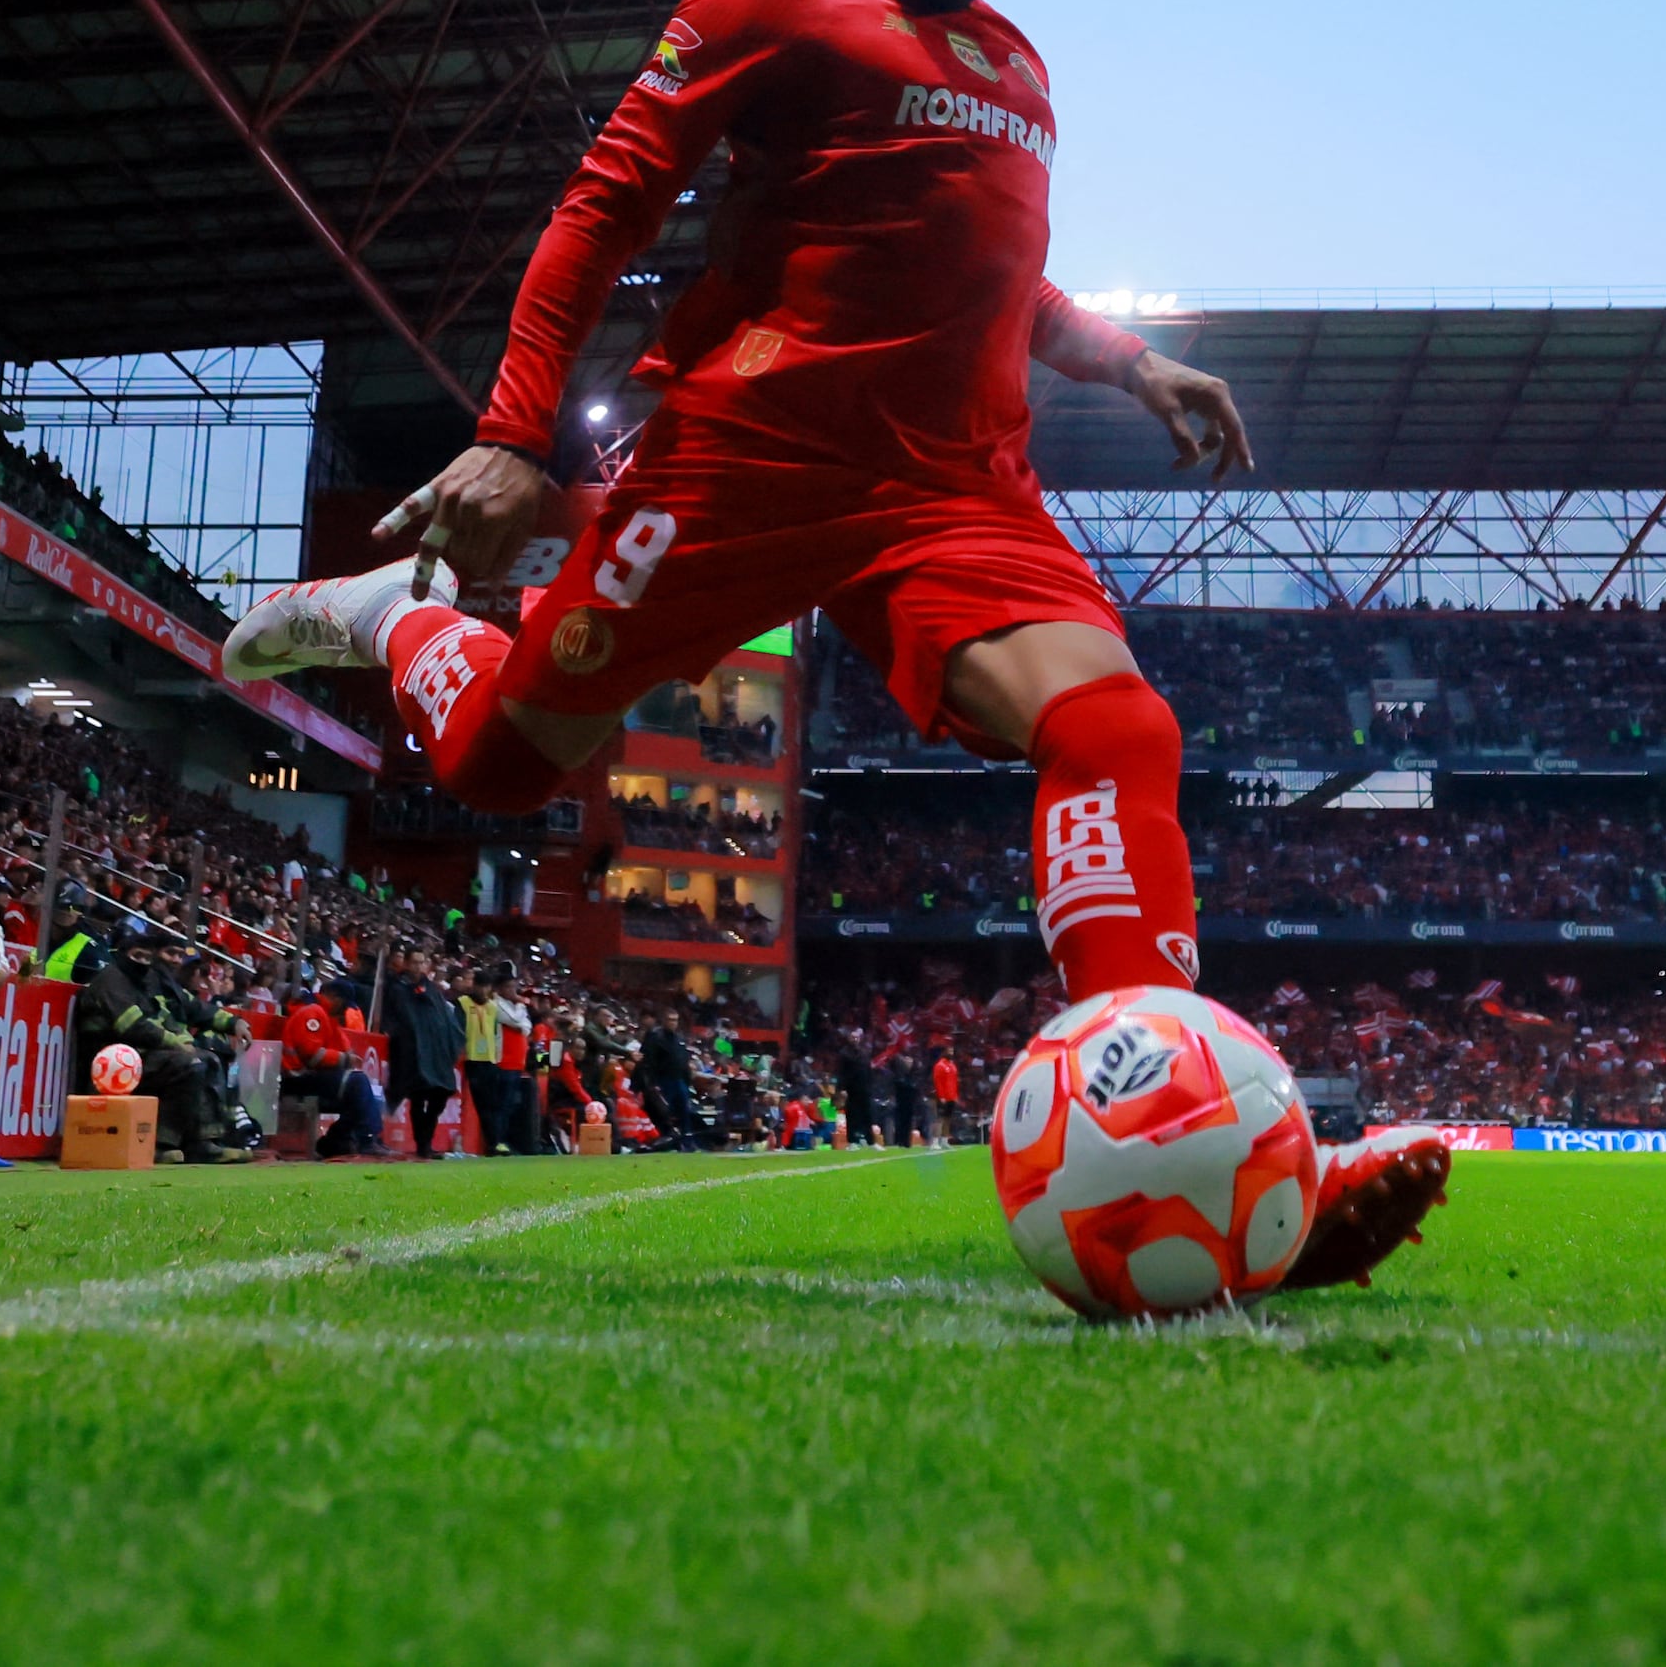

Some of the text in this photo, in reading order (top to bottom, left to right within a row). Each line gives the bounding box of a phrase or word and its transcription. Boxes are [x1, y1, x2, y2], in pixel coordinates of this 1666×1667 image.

[895, 84, 1055, 175] ROSHFRAN
[594, 504, 677, 610] 9
[92, 577, 155, 631] VOLVO
[1254, 755, 1298, 770] Corona
[1394, 756, 1438, 771] Corona
[1534, 757, 1578, 771] Corona
[838, 919, 890, 936] Corona
[976, 918, 1028, 936] Corona
[1265, 920, 1319, 939] Corona
[1411, 921, 1466, 939] Corona
[1560, 921, 1614, 940] Corona
